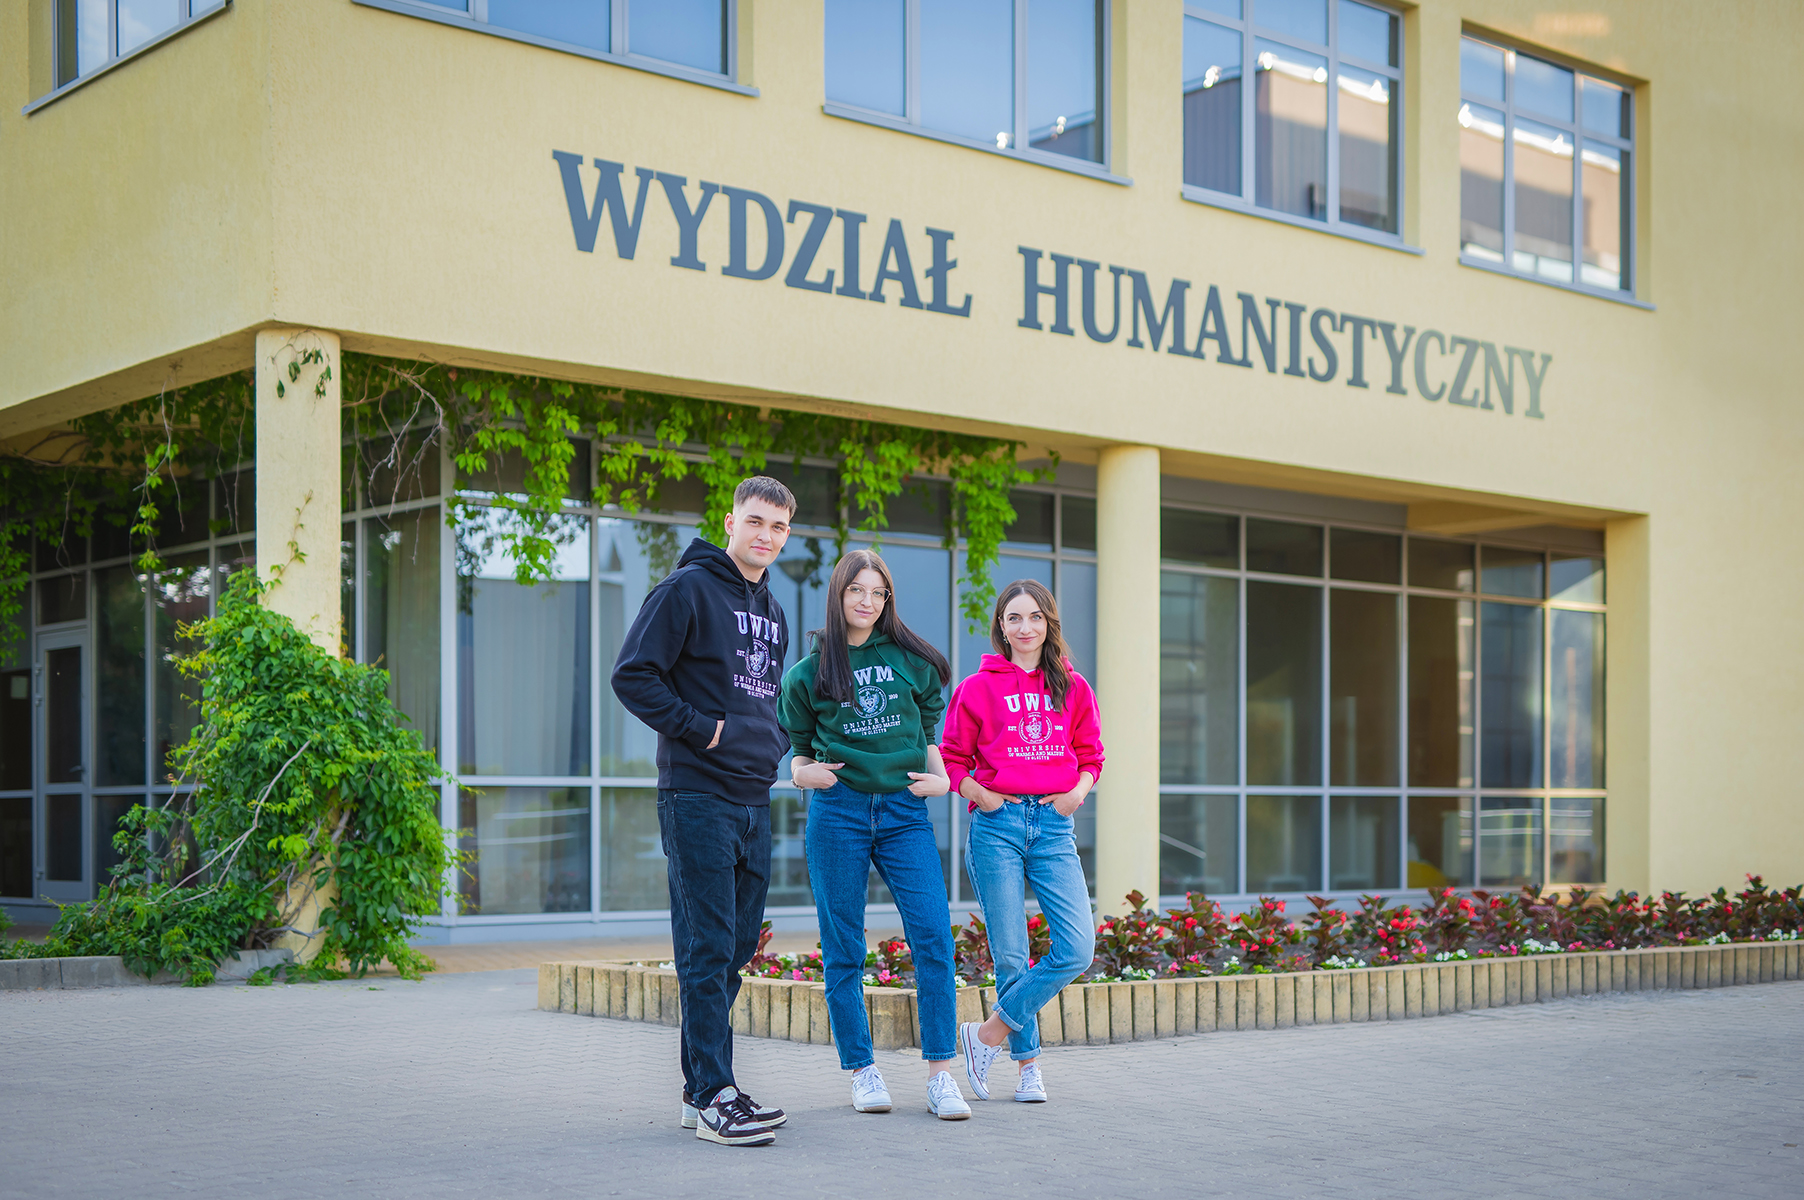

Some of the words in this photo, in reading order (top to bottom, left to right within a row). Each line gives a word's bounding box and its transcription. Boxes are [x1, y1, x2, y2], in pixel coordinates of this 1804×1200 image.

[552, 149, 973, 317] WYDZIAŁ
[1017, 245, 1554, 421] HUMANISTYCZNY
[733, 673, 777, 692] UNIVERSITY
[853, 665, 895, 686] WM
[843, 714, 901, 730] UNIVERSITY
